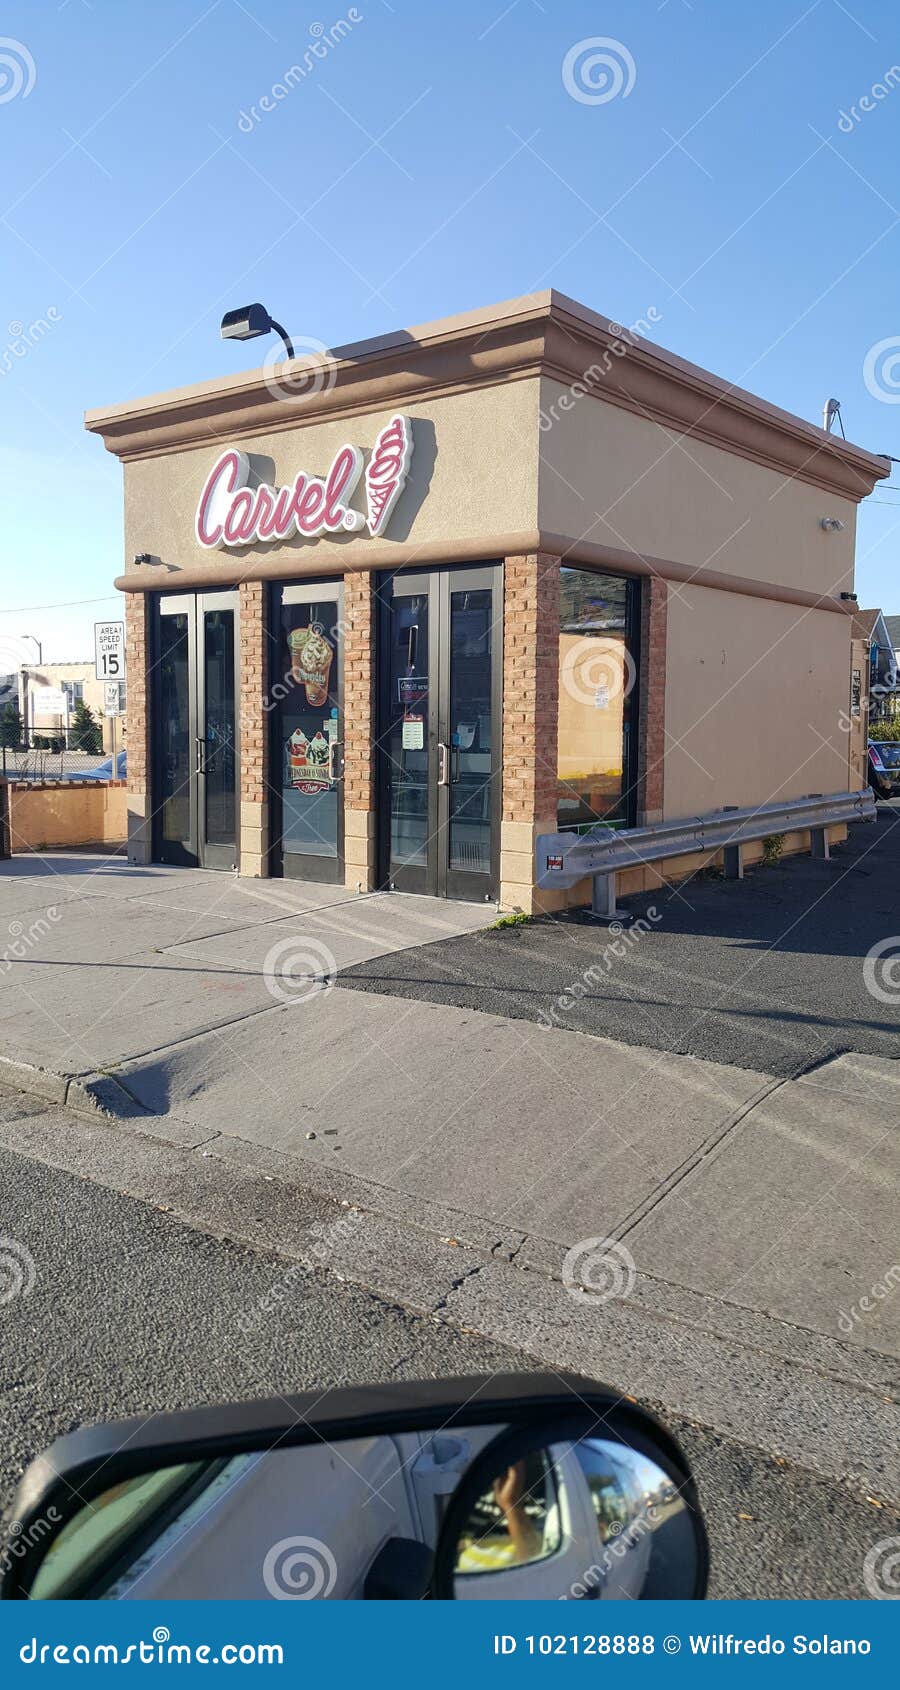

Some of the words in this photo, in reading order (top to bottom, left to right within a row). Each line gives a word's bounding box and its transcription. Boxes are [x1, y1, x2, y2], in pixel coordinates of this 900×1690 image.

[99, 635, 121, 644] SPEED
[102, 643, 118, 652] LIMIT
[102, 653, 120, 675] 15
